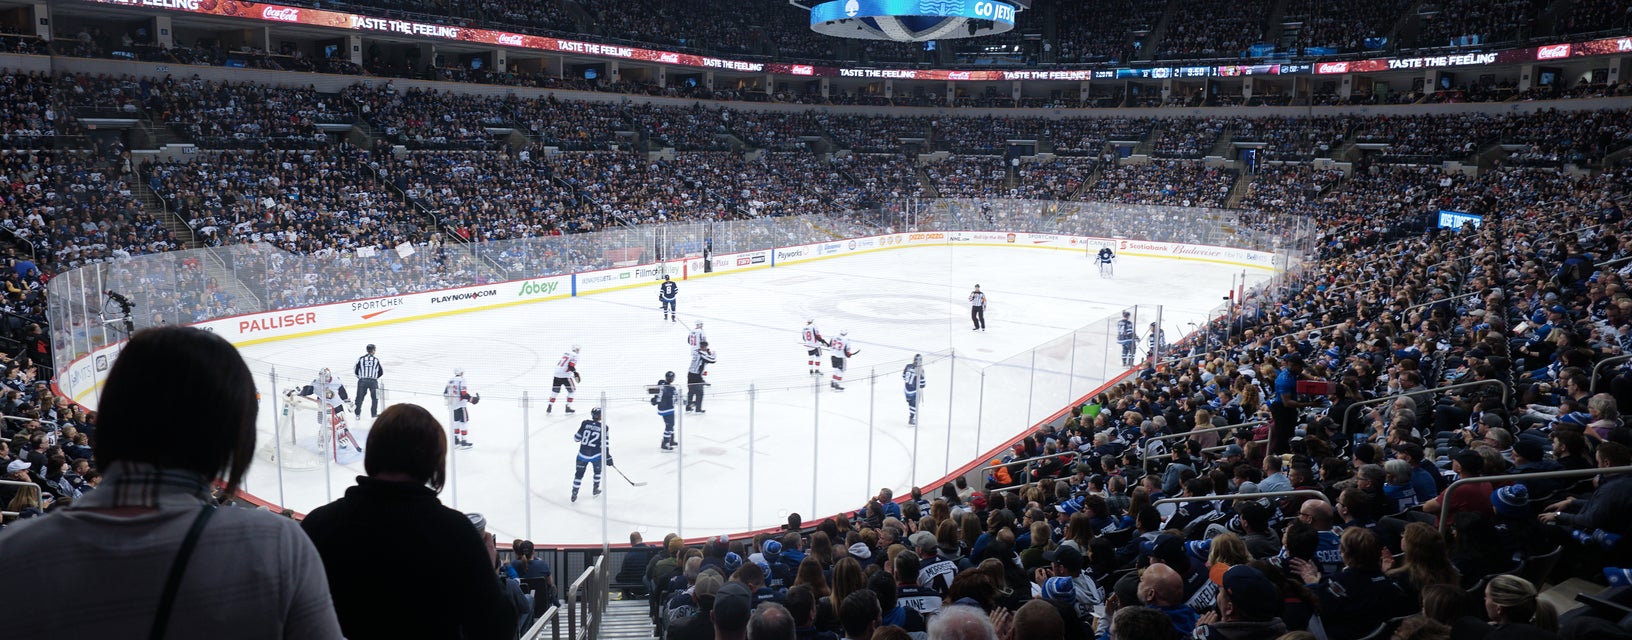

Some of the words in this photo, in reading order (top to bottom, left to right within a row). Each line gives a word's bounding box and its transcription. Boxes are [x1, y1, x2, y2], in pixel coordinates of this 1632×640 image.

[975, 1, 993, 17] GO
[993, 4, 1011, 21] JETS
[350, 15, 387, 31] TASTE
[388, 20, 410, 33] THE
[412, 23, 457, 38] FEELING
[557, 40, 583, 52] TASTE
[584, 43, 600, 54] THE
[600, 45, 632, 57] FEELING
[703, 58, 722, 68] TASTE
[722, 60, 734, 69] THE
[734, 61, 763, 71] FEELING
[1388, 58, 1422, 69] TASTE
[1424, 56, 1447, 67] THE
[1448, 53, 1495, 65] FEELING
[840, 68, 864, 77] TASTE
[864, 69, 881, 78] THE
[881, 70, 916, 79] FEELING
[1003, 71, 1030, 80] TASTE
[1031, 71, 1048, 80] THE
[1049, 71, 1086, 80] FEELING
[1174, 68, 1180, 77] 2
[1212, 67, 1217, 76] 1
[1129, 242, 1168, 252] Scotiabank
[1171, 244, 1221, 257] Budweiser
[777, 248, 802, 260] Payworks
[518, 281, 559, 296] Sobeys
[239, 312, 316, 333] PALLISER
[580, 429, 600, 448] 82
